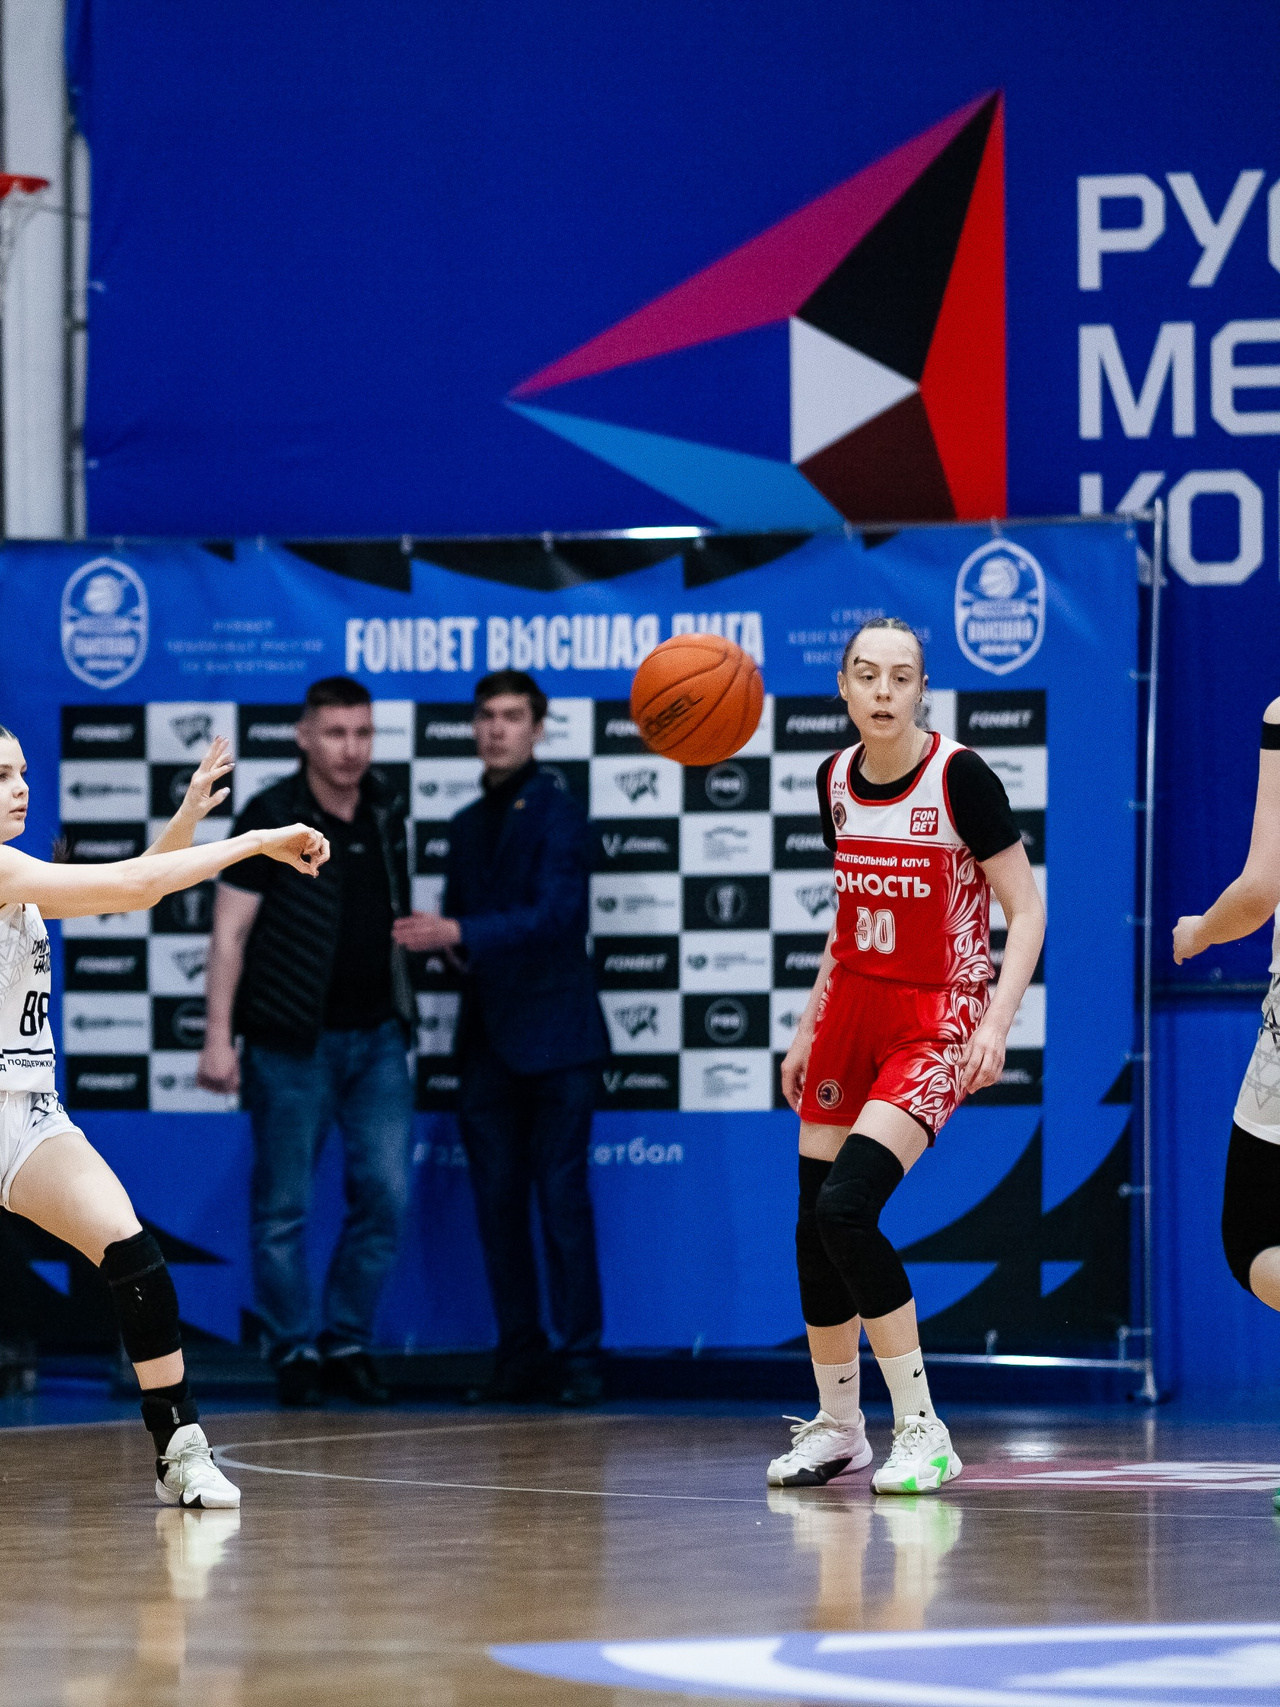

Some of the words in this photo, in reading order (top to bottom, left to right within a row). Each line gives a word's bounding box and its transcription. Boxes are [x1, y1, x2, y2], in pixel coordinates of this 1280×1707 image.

[1077, 168, 1280, 292] РУ
[1079, 468, 1280, 587] КО
[345, 616, 479, 674] FONBET
[486, 613, 660, 671] ВЫСШАЯ
[911, 821, 936, 833] BET
[912, 810, 936, 821] FON
[835, 851, 898, 868] АСКЕТБОЛЬНЫЙ
[901, 857, 931, 868] КЛУБ
[854, 906, 897, 956] 30
[7, 1058, 53, 1069] ПОДДЕРЖКИ
[589, 1136, 684, 1165] етбол
